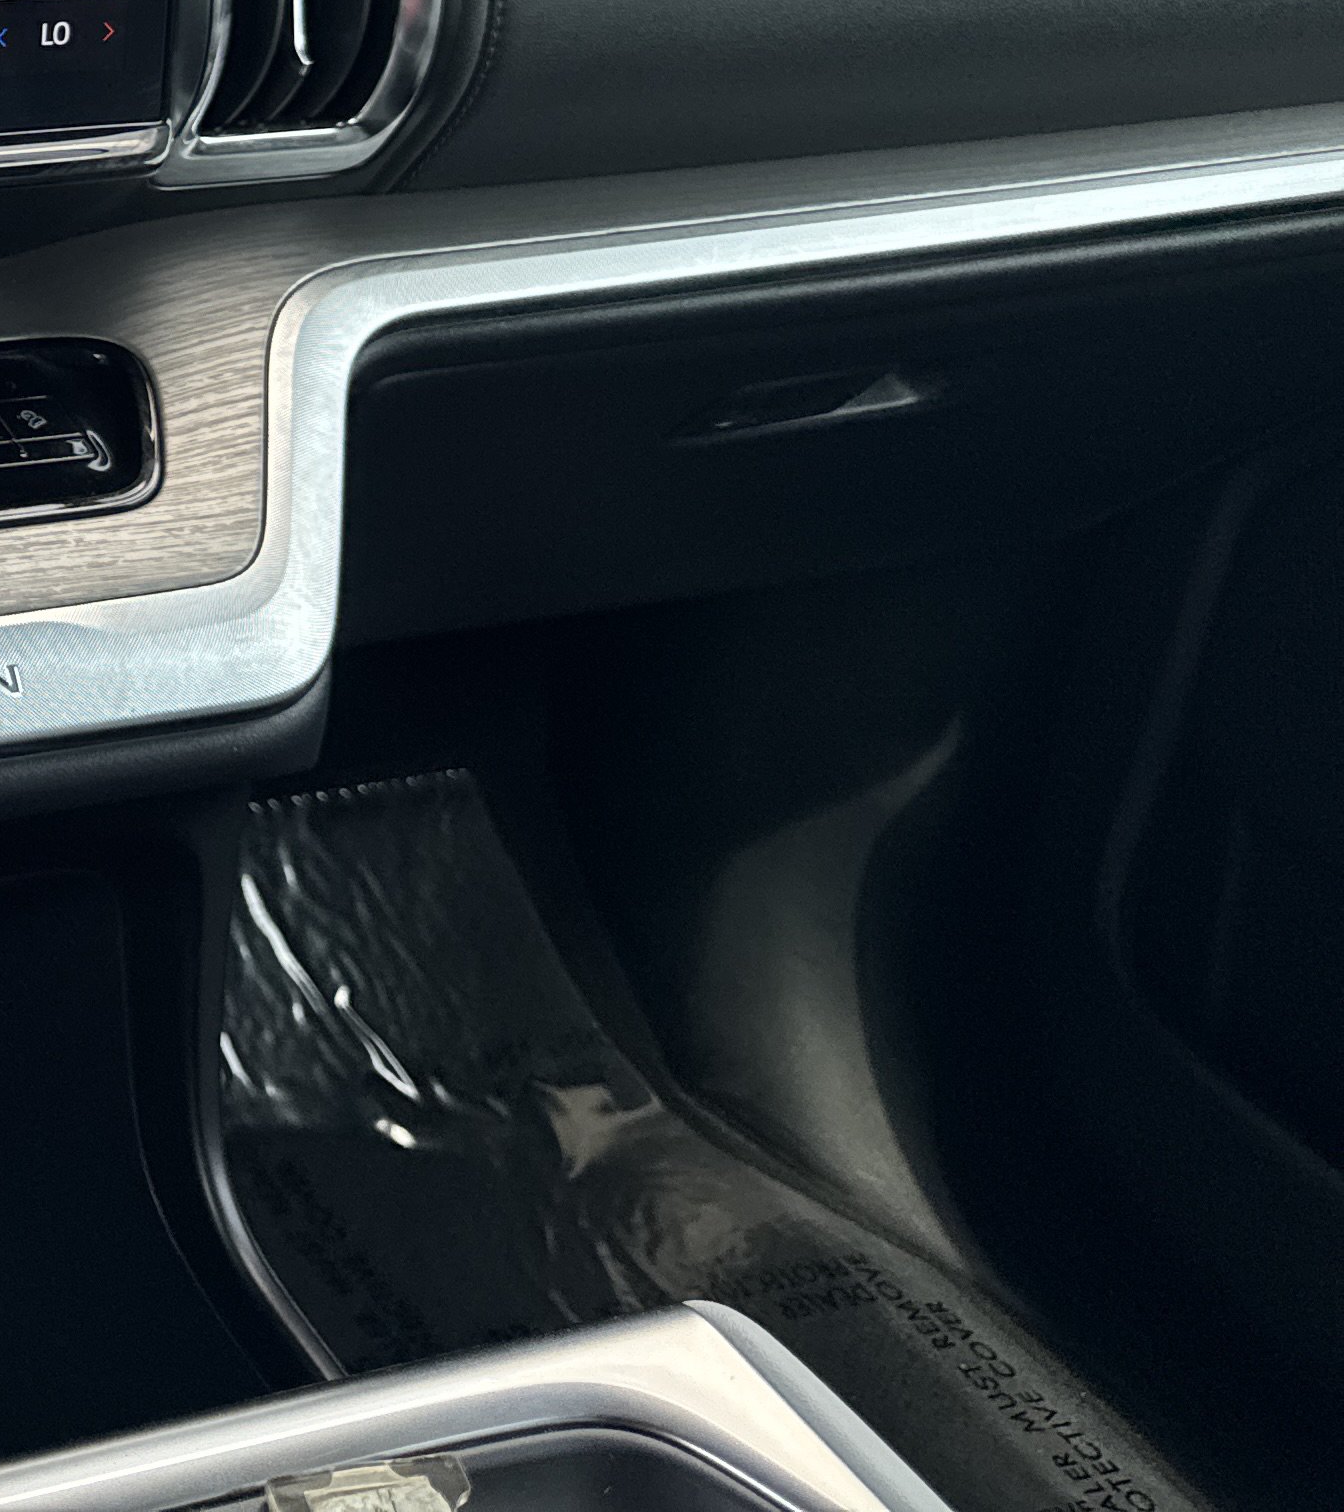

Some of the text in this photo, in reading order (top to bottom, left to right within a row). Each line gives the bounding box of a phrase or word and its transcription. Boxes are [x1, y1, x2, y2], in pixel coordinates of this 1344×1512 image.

[40, 20, 71, 47] LO
[925, 1300, 1017, 1379] COVER
[958, 1362, 1047, 1434] MUST
